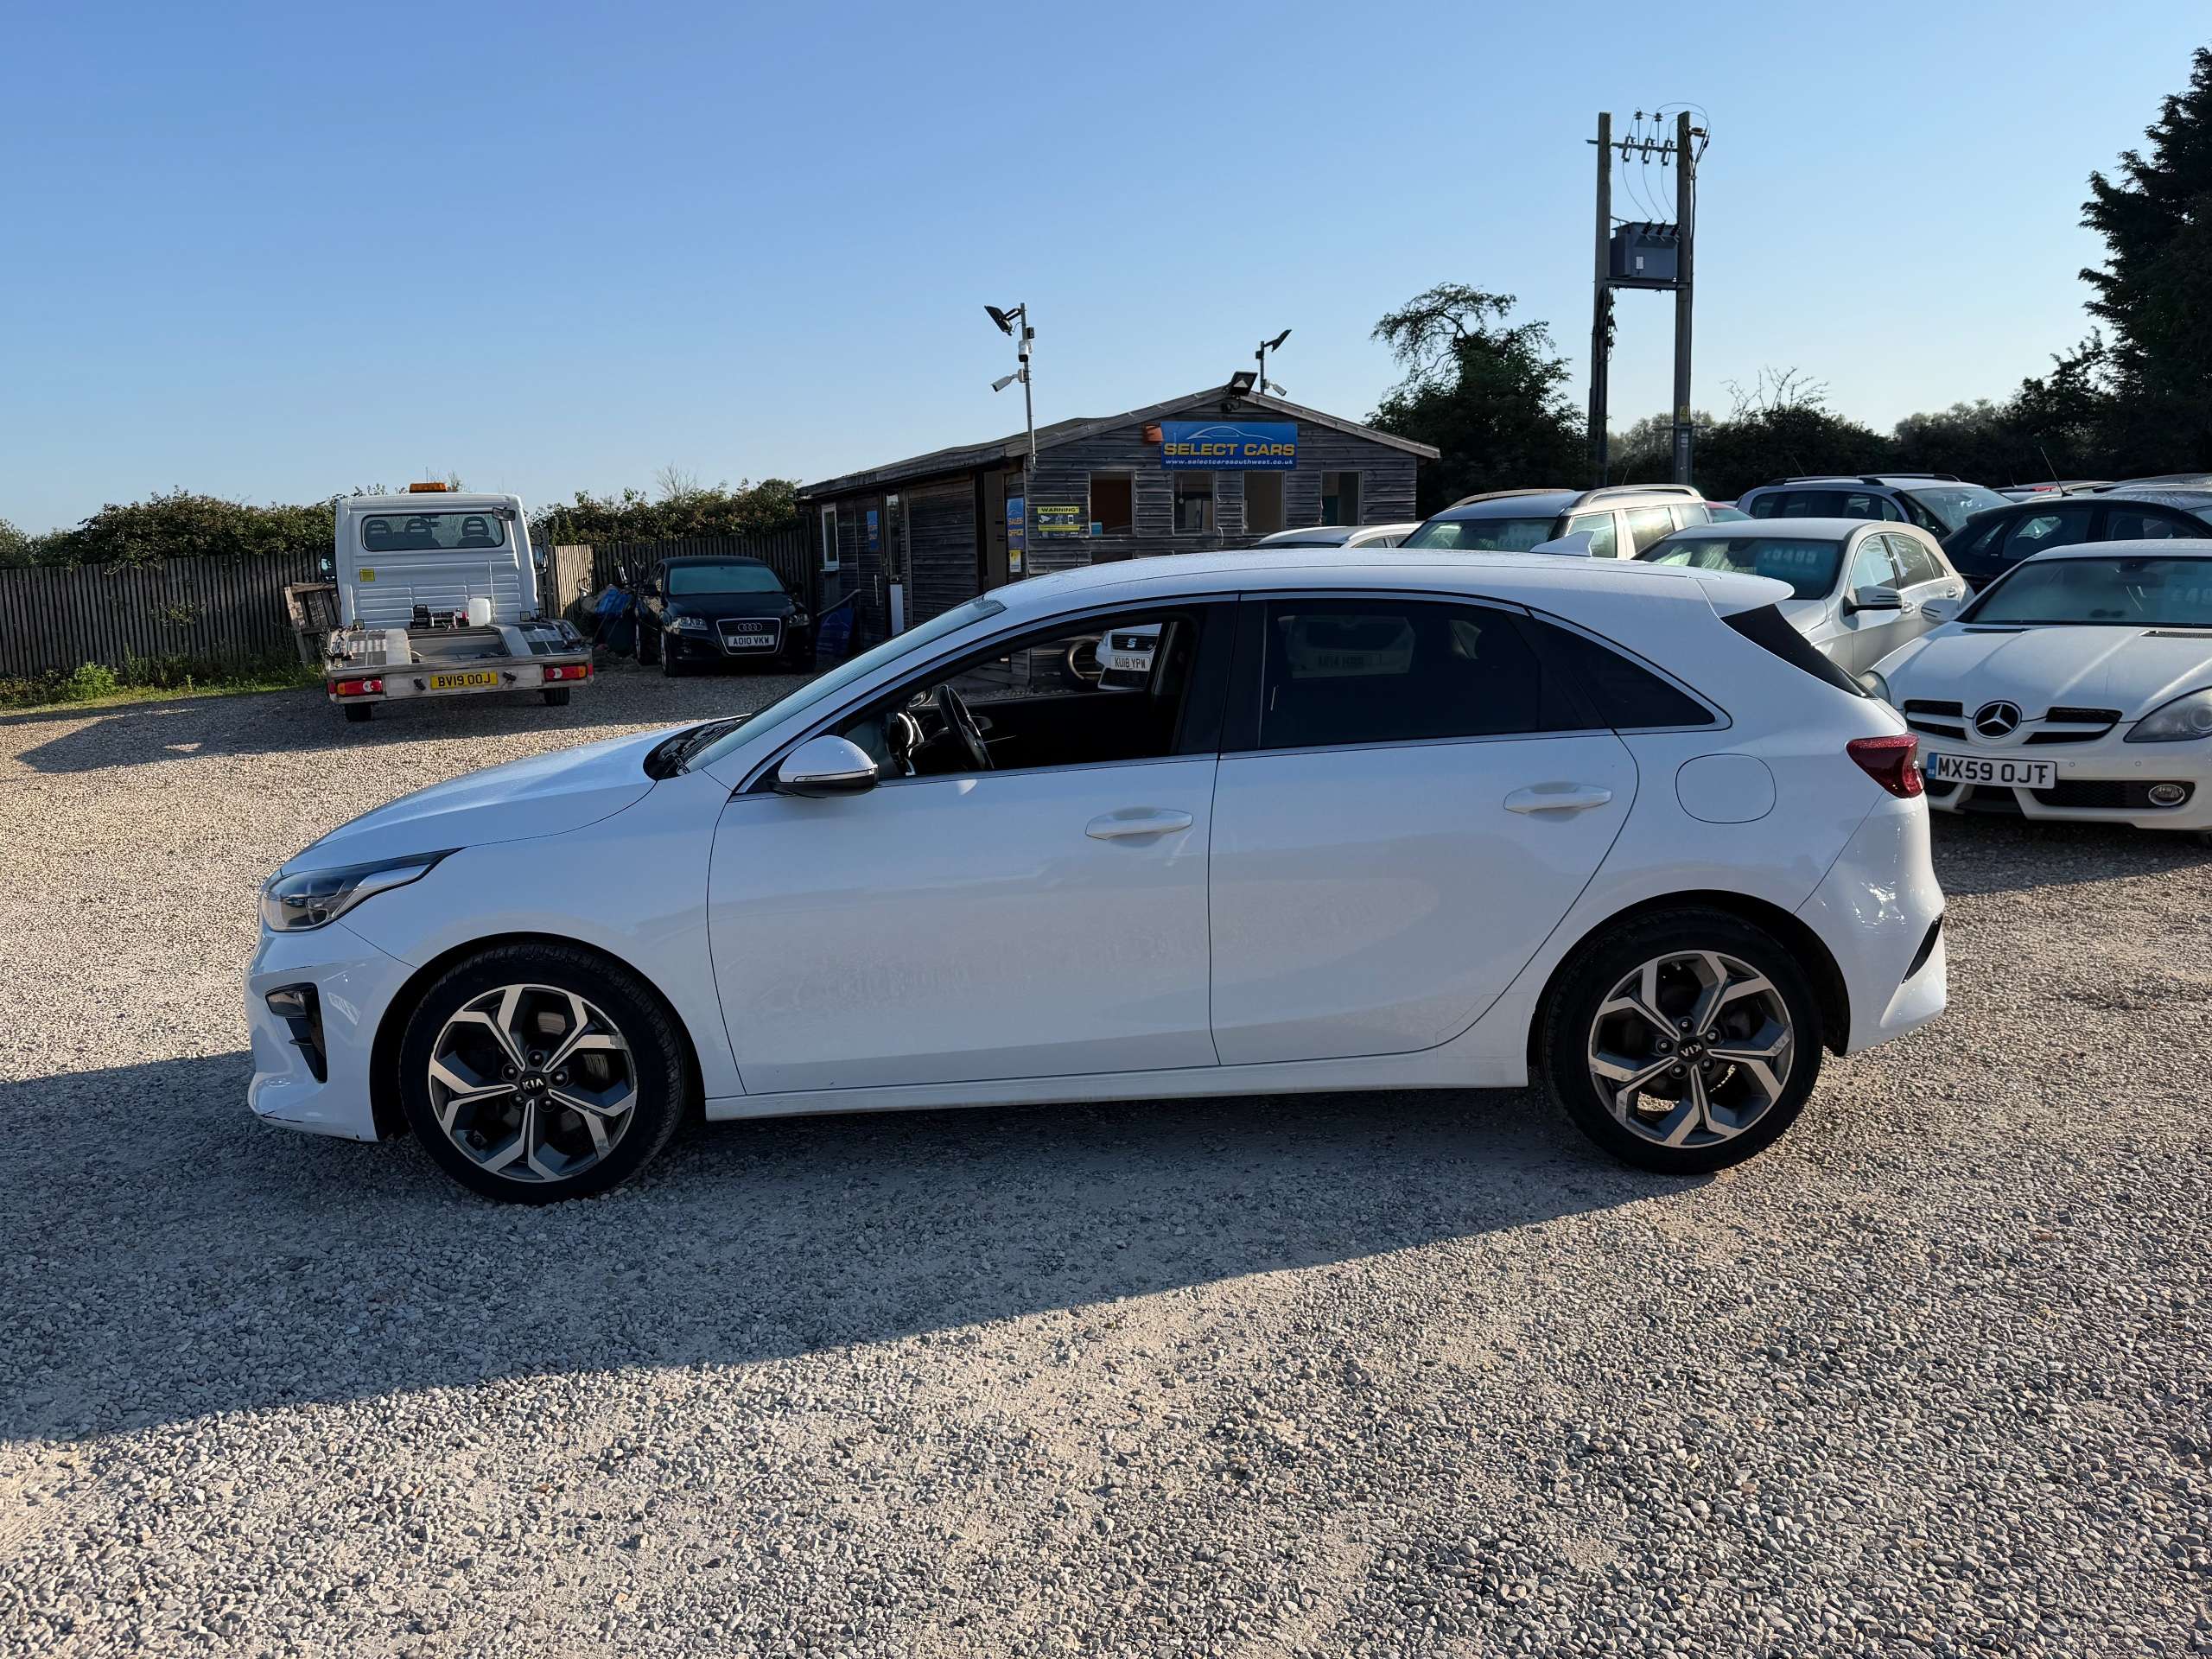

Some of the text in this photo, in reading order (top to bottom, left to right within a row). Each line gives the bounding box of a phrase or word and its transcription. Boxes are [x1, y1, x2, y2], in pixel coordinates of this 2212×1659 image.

[1164, 442, 1295, 456] SELECT CARS
[438, 672, 491, 687] BV19 OOJ
[1938, 757, 2049, 784] MX59 OJT
[522, 1077, 544, 1090] KIA
